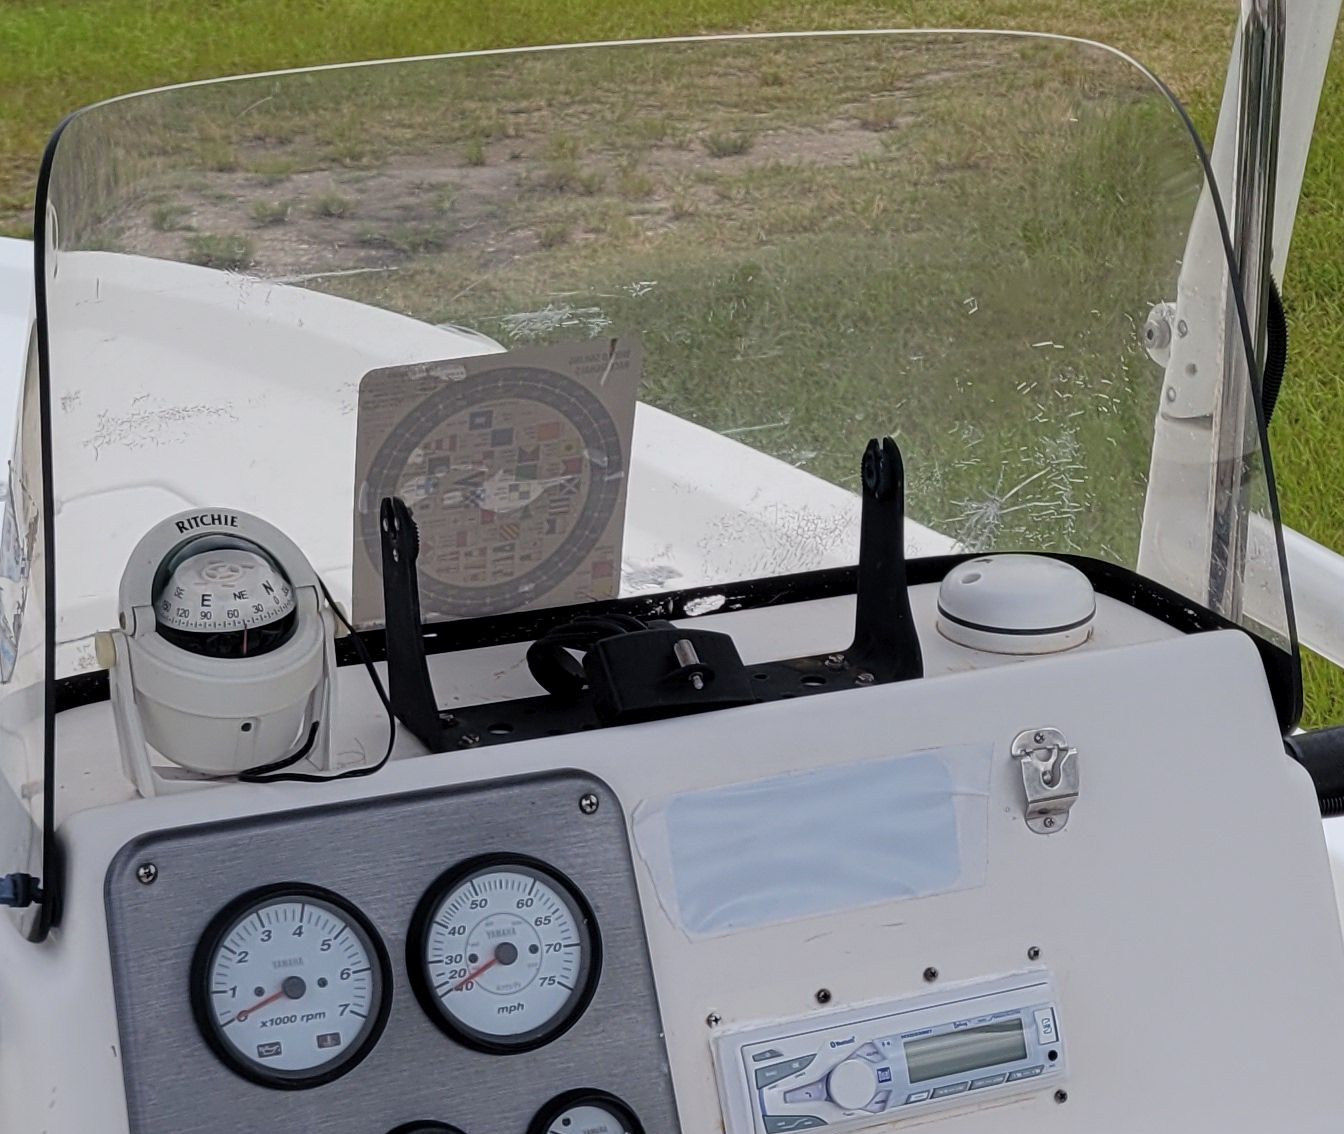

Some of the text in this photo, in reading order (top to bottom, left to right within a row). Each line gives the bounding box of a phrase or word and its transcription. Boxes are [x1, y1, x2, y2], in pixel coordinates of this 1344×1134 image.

[175, 514, 239, 534] RITCHIE
[201, 594, 212, 607] E
[233, 589, 248, 601] NE
[262, 580, 275, 596] N
[176, 608, 190, 619] 120
[200, 611, 212, 620] 90
[227, 609, 239, 619] 60
[252, 603, 264, 614] 30
[470, 898, 488, 910] 50
[516, 897, 534, 909] 60
[534, 915, 552, 926] 65
[260, 930, 272, 943] 3
[292, 925, 304, 938] 4
[448, 925, 466, 936] 40
[320, 939, 333, 951] 5
[544, 942, 562, 954] 70
[236, 951, 249, 964] 2
[444, 954, 463, 965] 30
[340, 968, 351, 981] 6
[448, 968, 467, 980] 20
[539, 976, 556, 987] 75
[229, 986, 238, 998] 1
[338, 1003, 351, 1017] 7
[497, 1002, 524, 1015] mph
[259, 1012, 326, 1029] x1000 rpm
